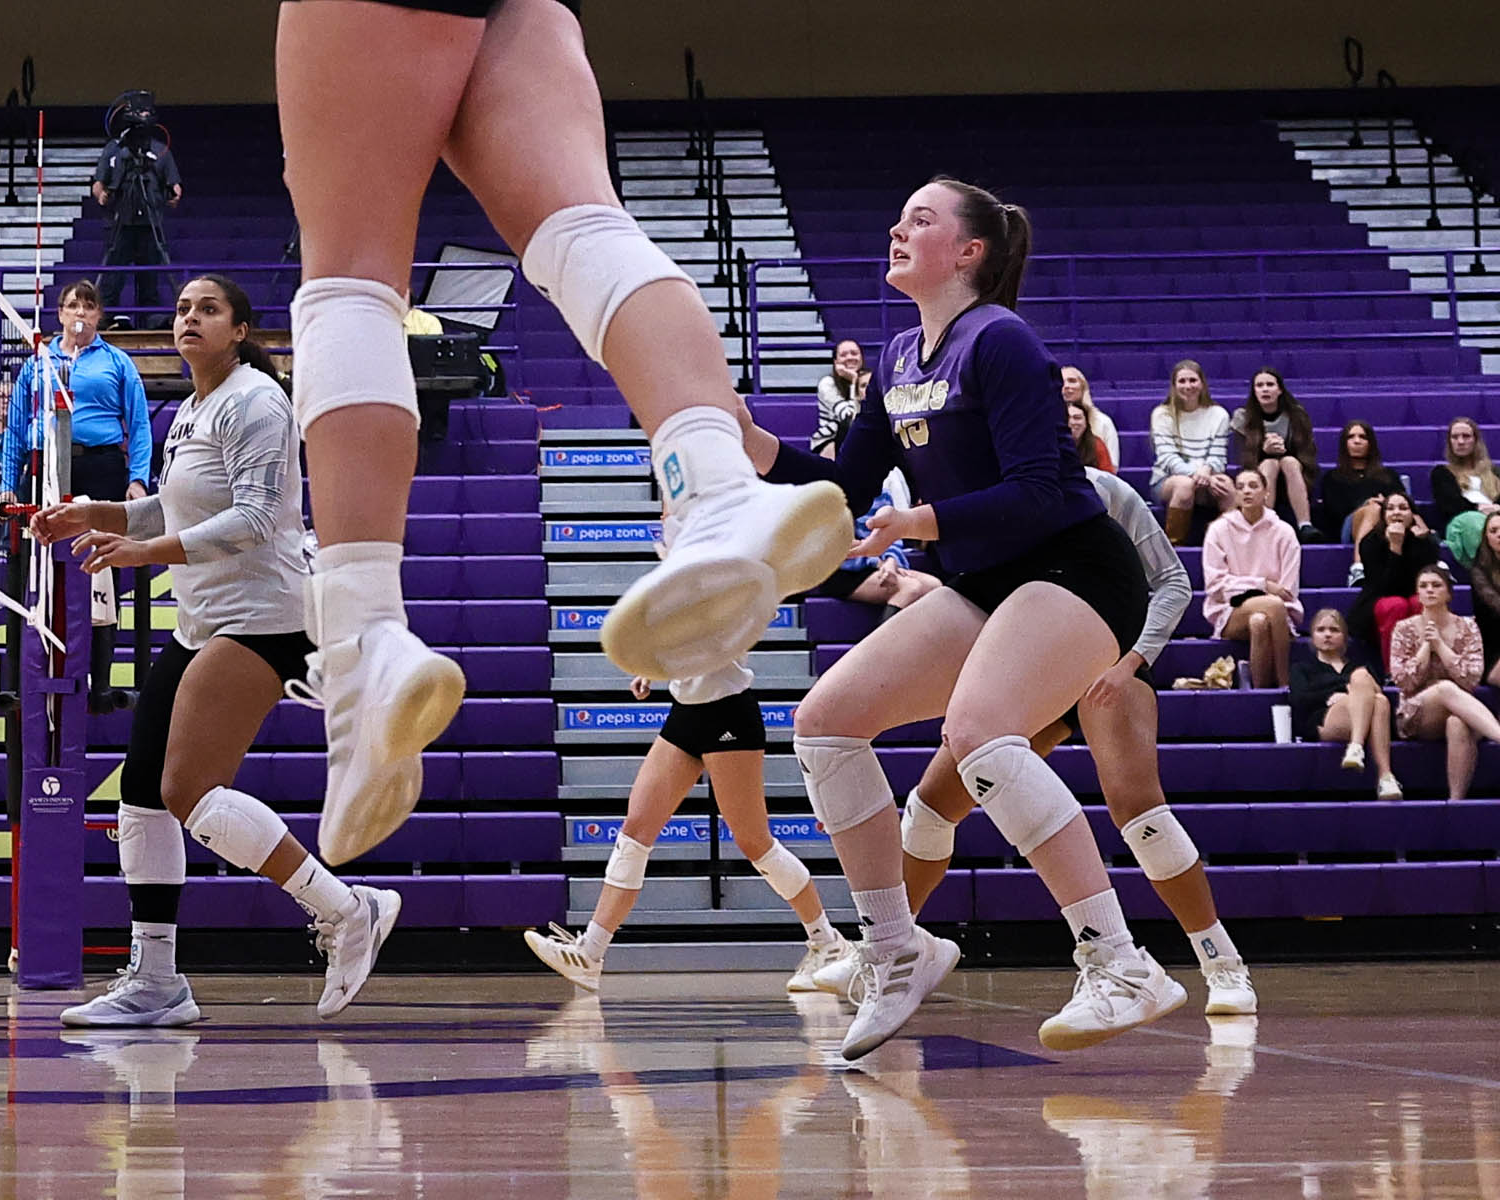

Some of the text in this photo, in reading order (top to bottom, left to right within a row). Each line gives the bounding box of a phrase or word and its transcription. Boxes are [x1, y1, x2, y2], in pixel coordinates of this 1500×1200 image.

[572, 452, 635, 465] pepsi zone
[579, 527, 646, 540] pepsi zone
[596, 711, 669, 725] pepsi zon
[761, 710, 786, 722] one
[660, 824, 689, 837] one
[773, 823, 810, 836] zone
